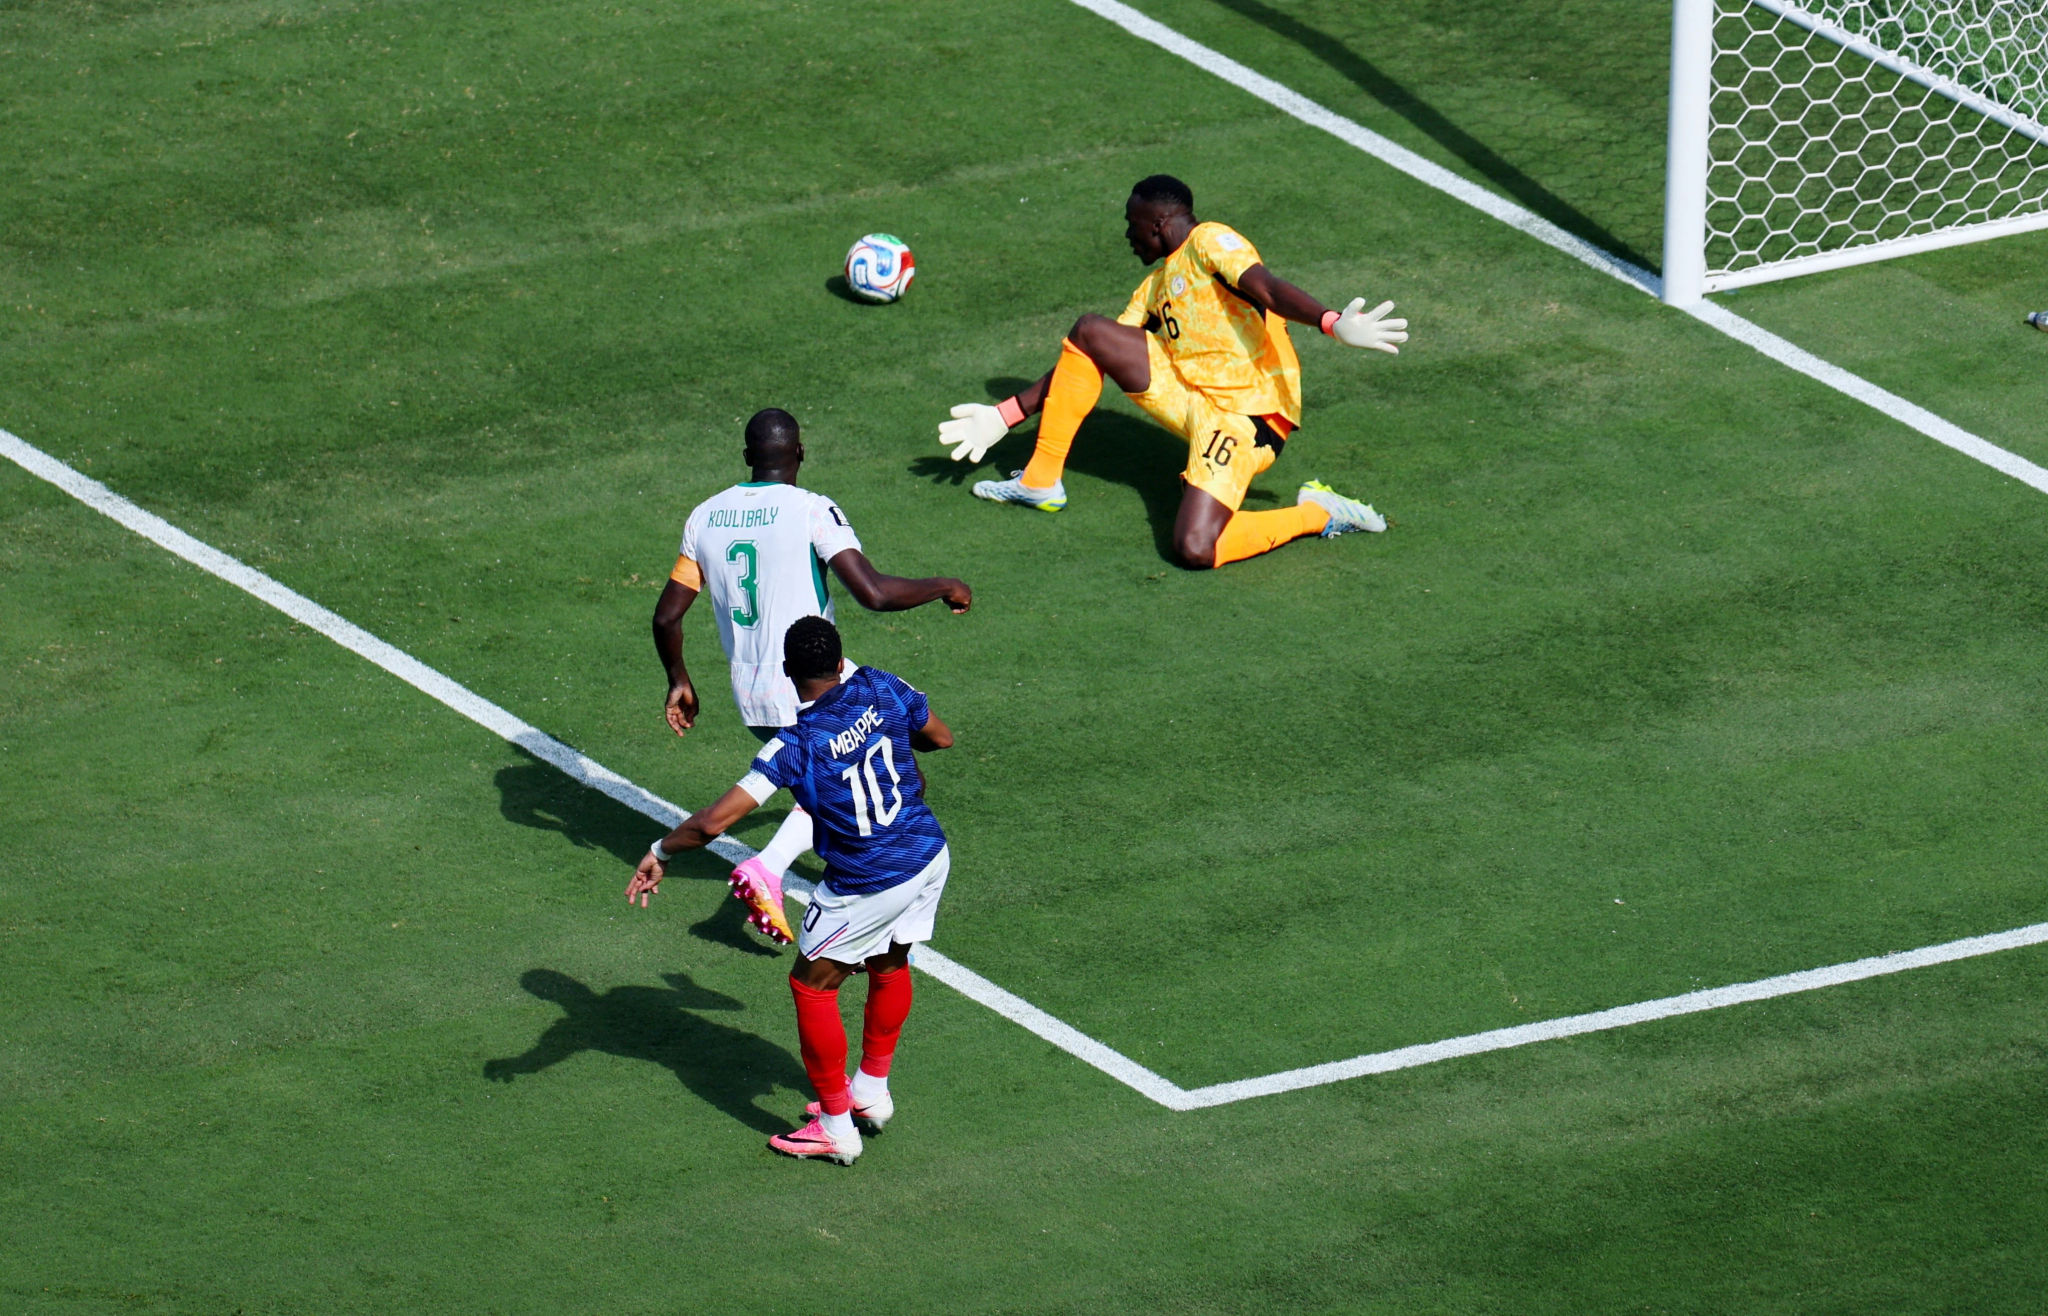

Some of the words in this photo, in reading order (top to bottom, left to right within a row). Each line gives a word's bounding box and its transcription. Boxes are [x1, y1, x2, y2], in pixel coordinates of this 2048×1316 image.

[1157, 298, 1180, 341] 6
[1202, 429, 1238, 467] 16
[707, 506, 779, 529] KOULIBALY
[726, 539, 761, 631] 3
[829, 704, 884, 760] MBAPPE
[842, 736, 902, 837] 10
[803, 901, 822, 933] 0
